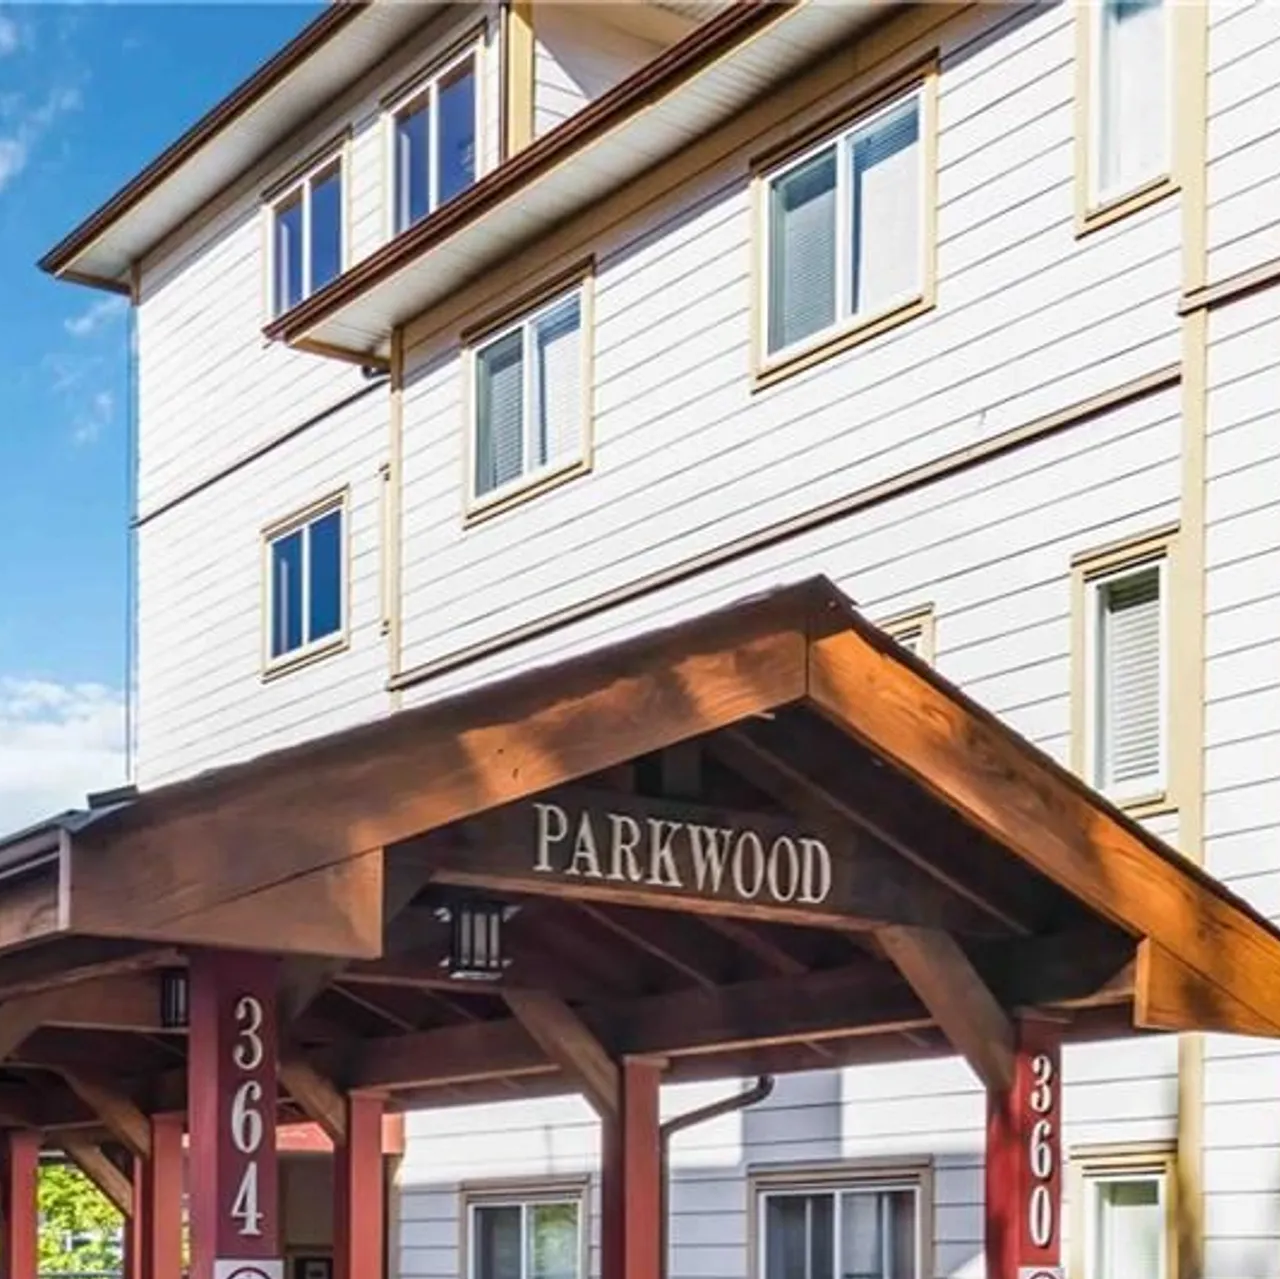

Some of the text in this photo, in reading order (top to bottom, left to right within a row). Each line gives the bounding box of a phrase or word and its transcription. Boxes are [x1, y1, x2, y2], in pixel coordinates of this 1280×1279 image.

[532, 803, 832, 904] PARKWOOD
[231, 997, 263, 1237] 364
[1028, 1054, 1053, 1248] 360
